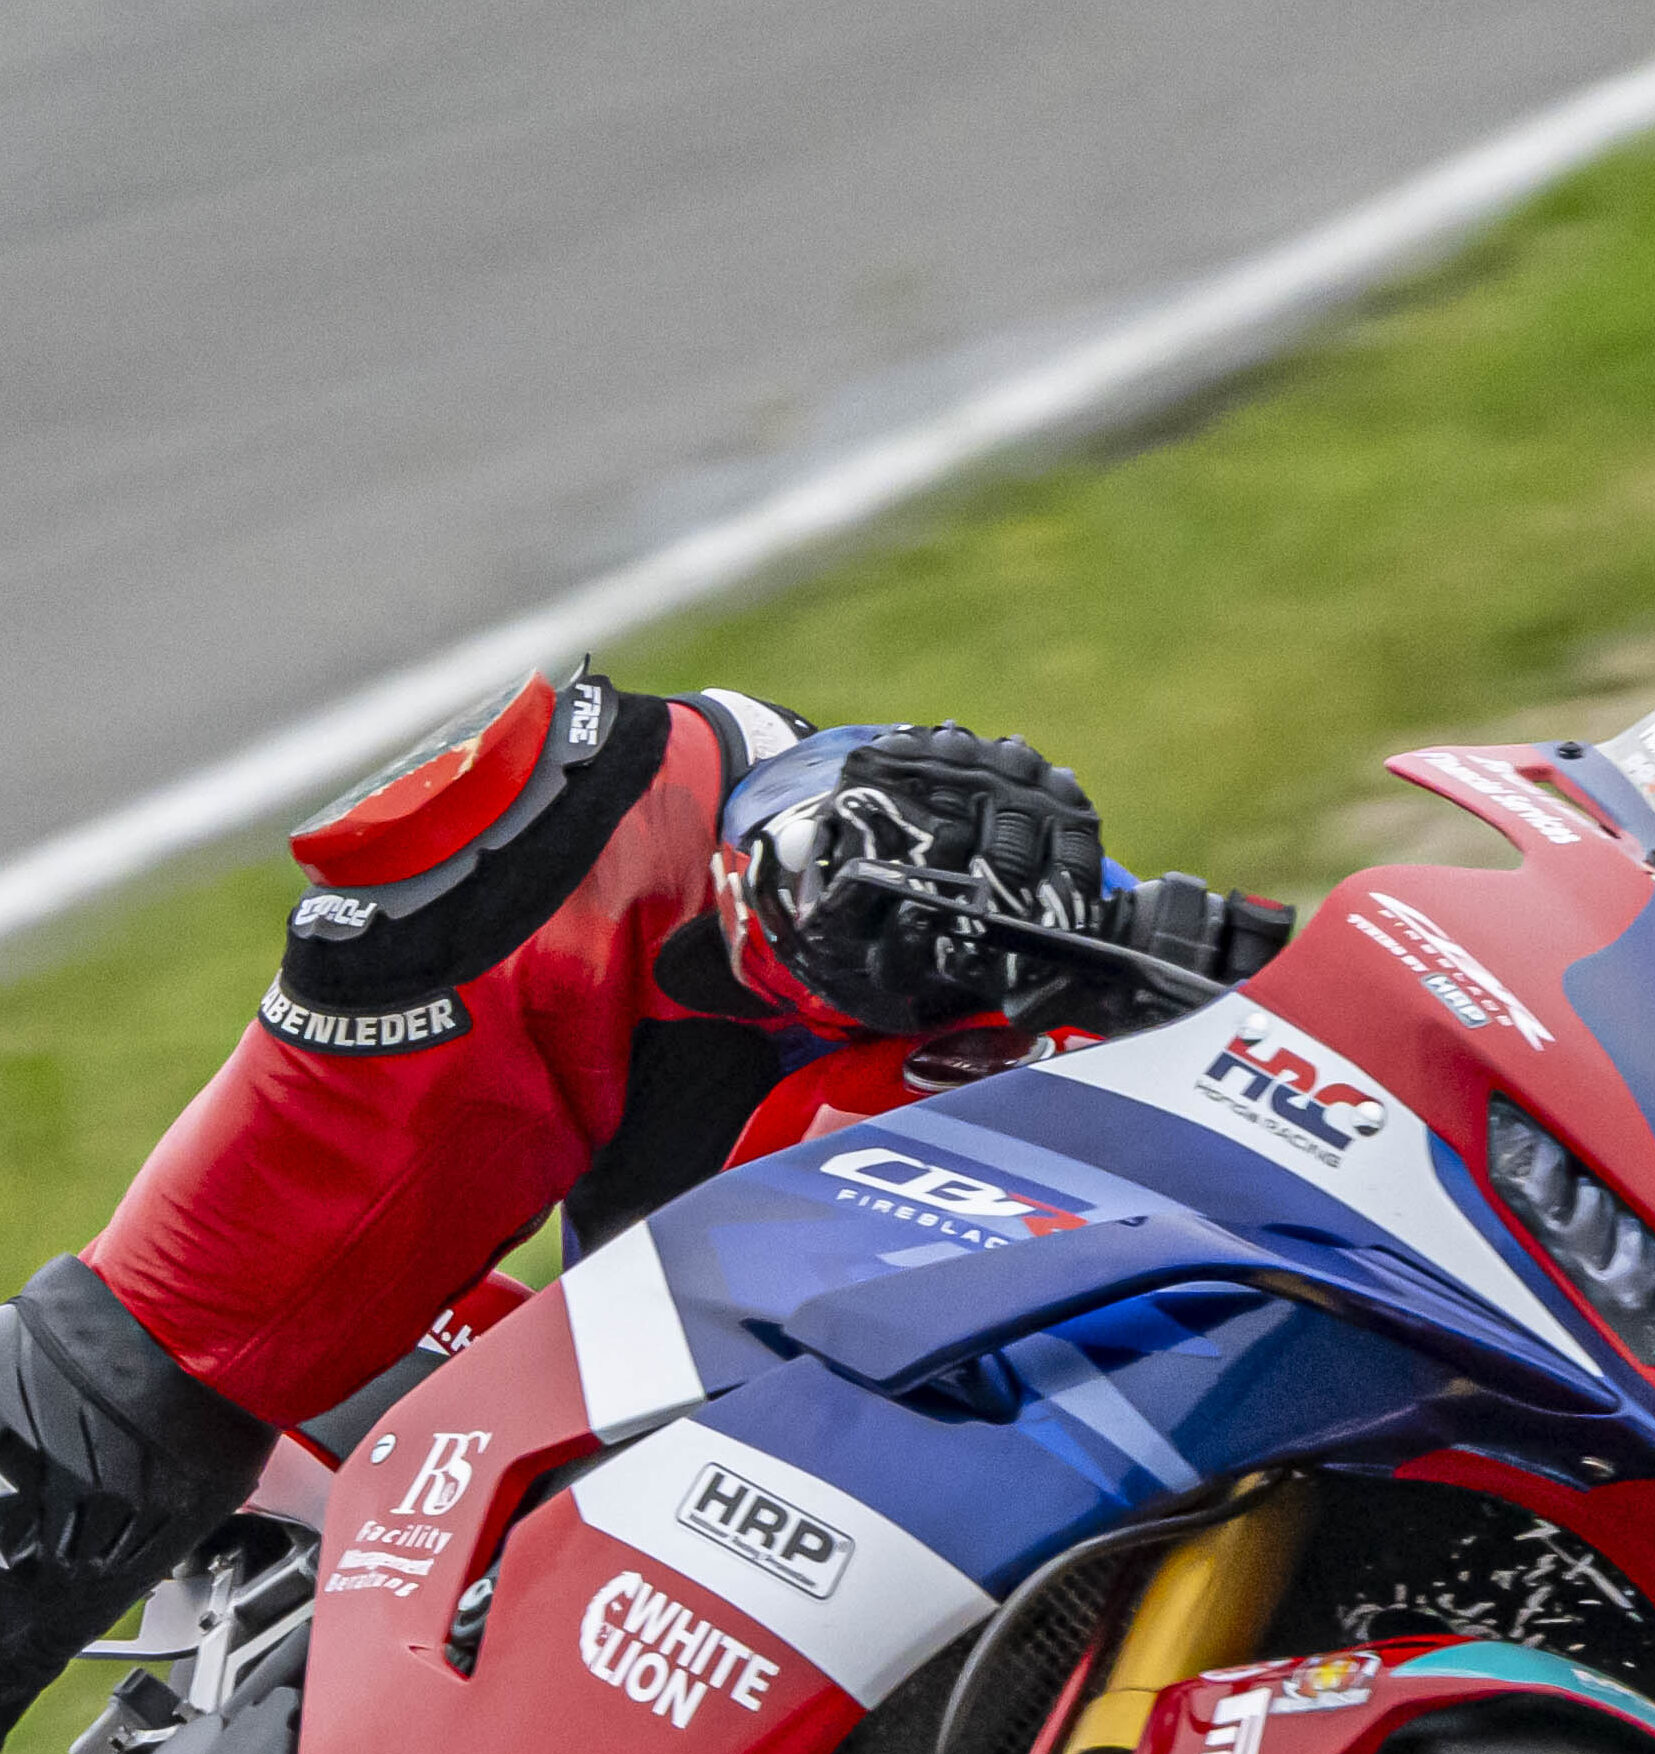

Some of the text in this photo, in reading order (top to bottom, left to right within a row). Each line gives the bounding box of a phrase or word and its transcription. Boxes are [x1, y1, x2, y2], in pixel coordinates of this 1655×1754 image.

[1205, 1036, 1387, 1151] HRC
[355, 1520, 455, 1555] Facility
[694, 1471, 835, 1564] HRP
[590, 1627, 708, 1730] LION
[622, 1581, 781, 1712] WHITE
